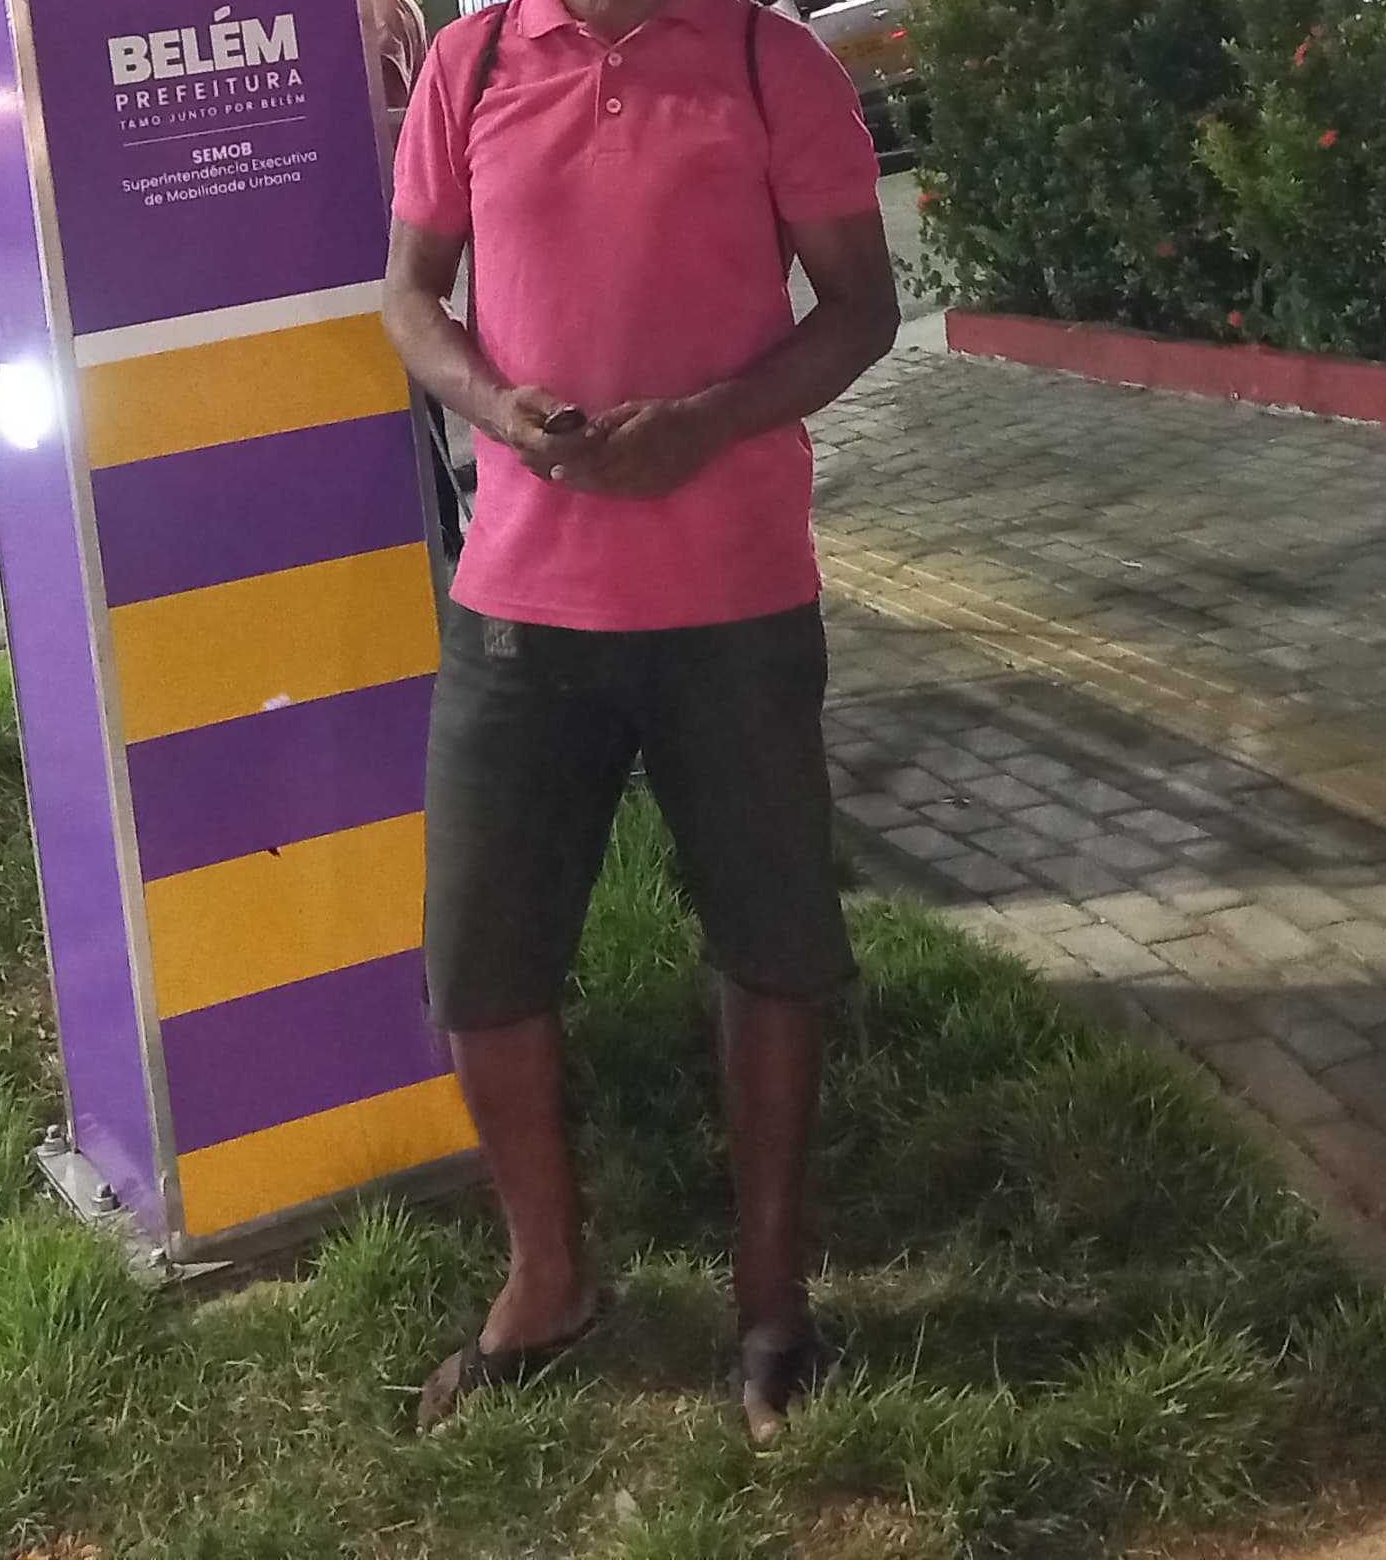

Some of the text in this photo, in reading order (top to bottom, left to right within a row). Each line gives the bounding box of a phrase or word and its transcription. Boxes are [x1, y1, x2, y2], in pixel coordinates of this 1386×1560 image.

[108, 5, 299, 85] BELÉM
[116, 68, 303, 112] PREFEITURA
[120, 93, 306, 130] TAMO JUNTO POR BELÉM
[122, 151, 318, 193] Superintendência Executiva
[192, 142, 253, 165] SEMOB
[144, 171, 301, 206] de Mobilidade Urbana
